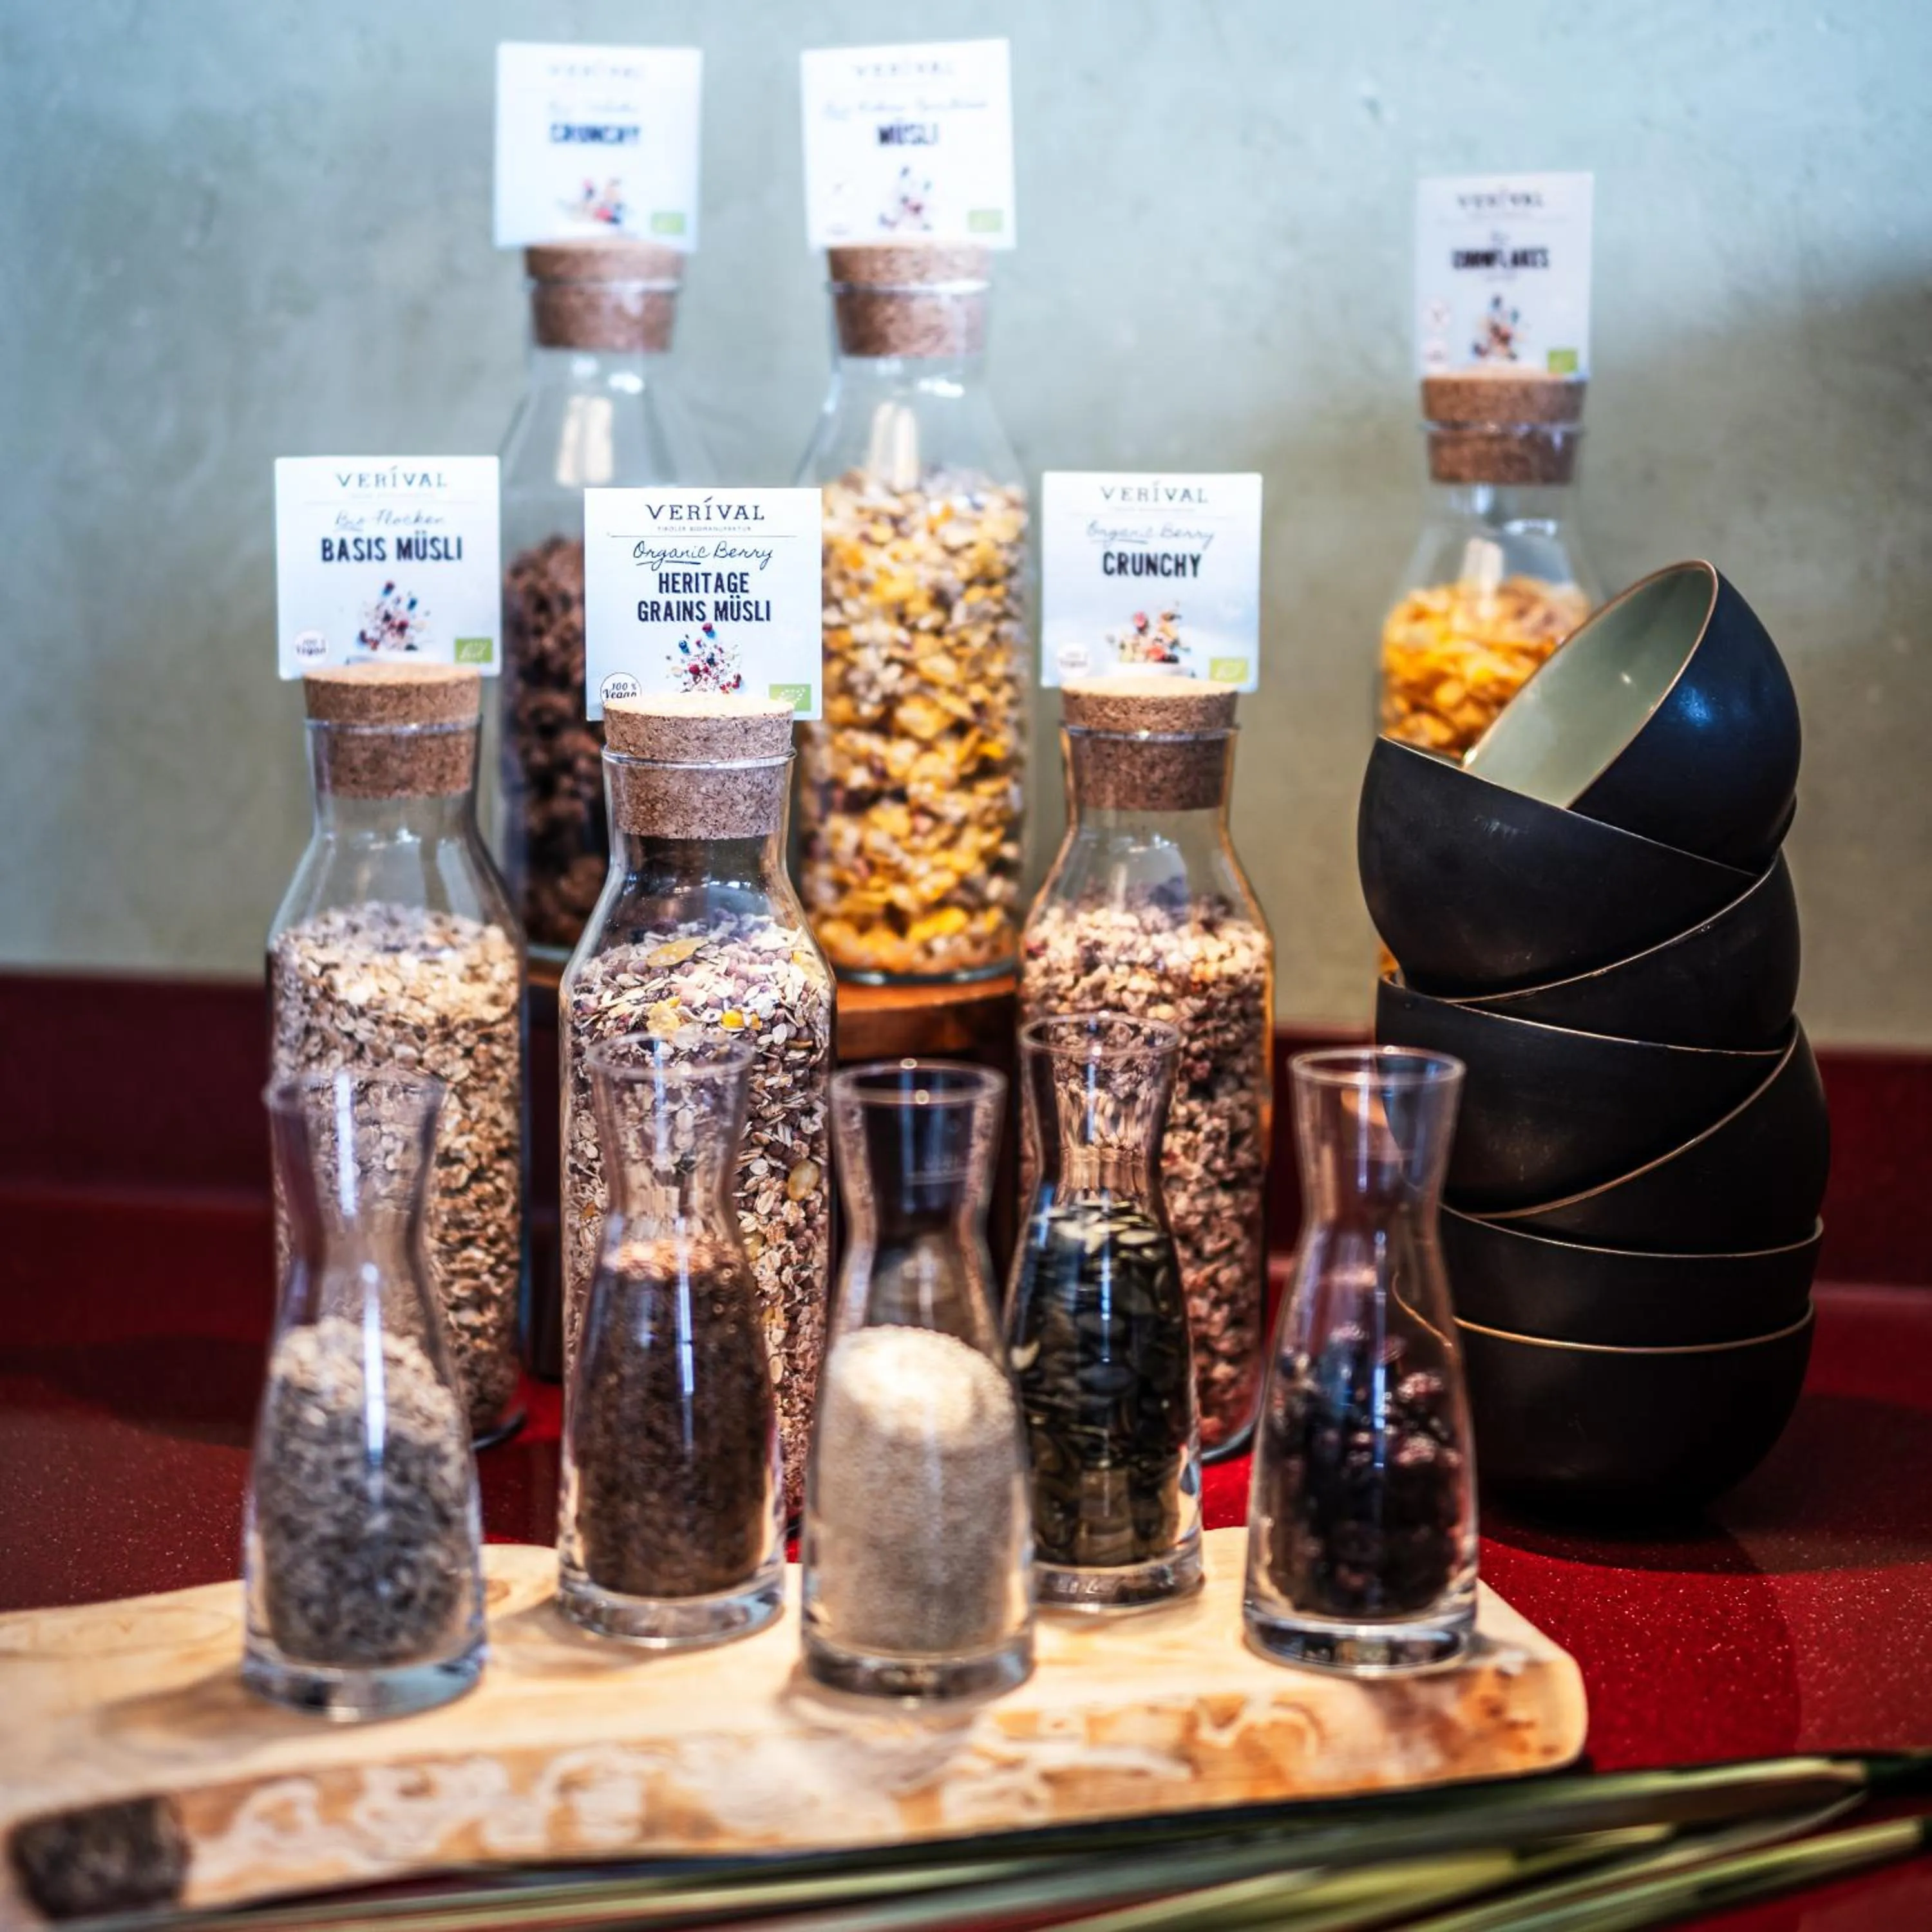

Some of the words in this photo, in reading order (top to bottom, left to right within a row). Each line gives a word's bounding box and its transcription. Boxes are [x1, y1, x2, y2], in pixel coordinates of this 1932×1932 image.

[336, 465, 448, 488] VERÍVAL
[645, 496, 764, 520] VERÍVAL
[321, 538, 386, 562] BASIS
[397, 530, 462, 561] MÜSLI
[633, 540, 710, 571] Organic
[714, 540, 773, 570] Berry
[1103, 551, 1201, 577] CRUNCHY
[659, 572, 750, 593] HERITAGE
[637, 600, 706, 621] GRAINS
[714, 594, 771, 621] MÜSLI
